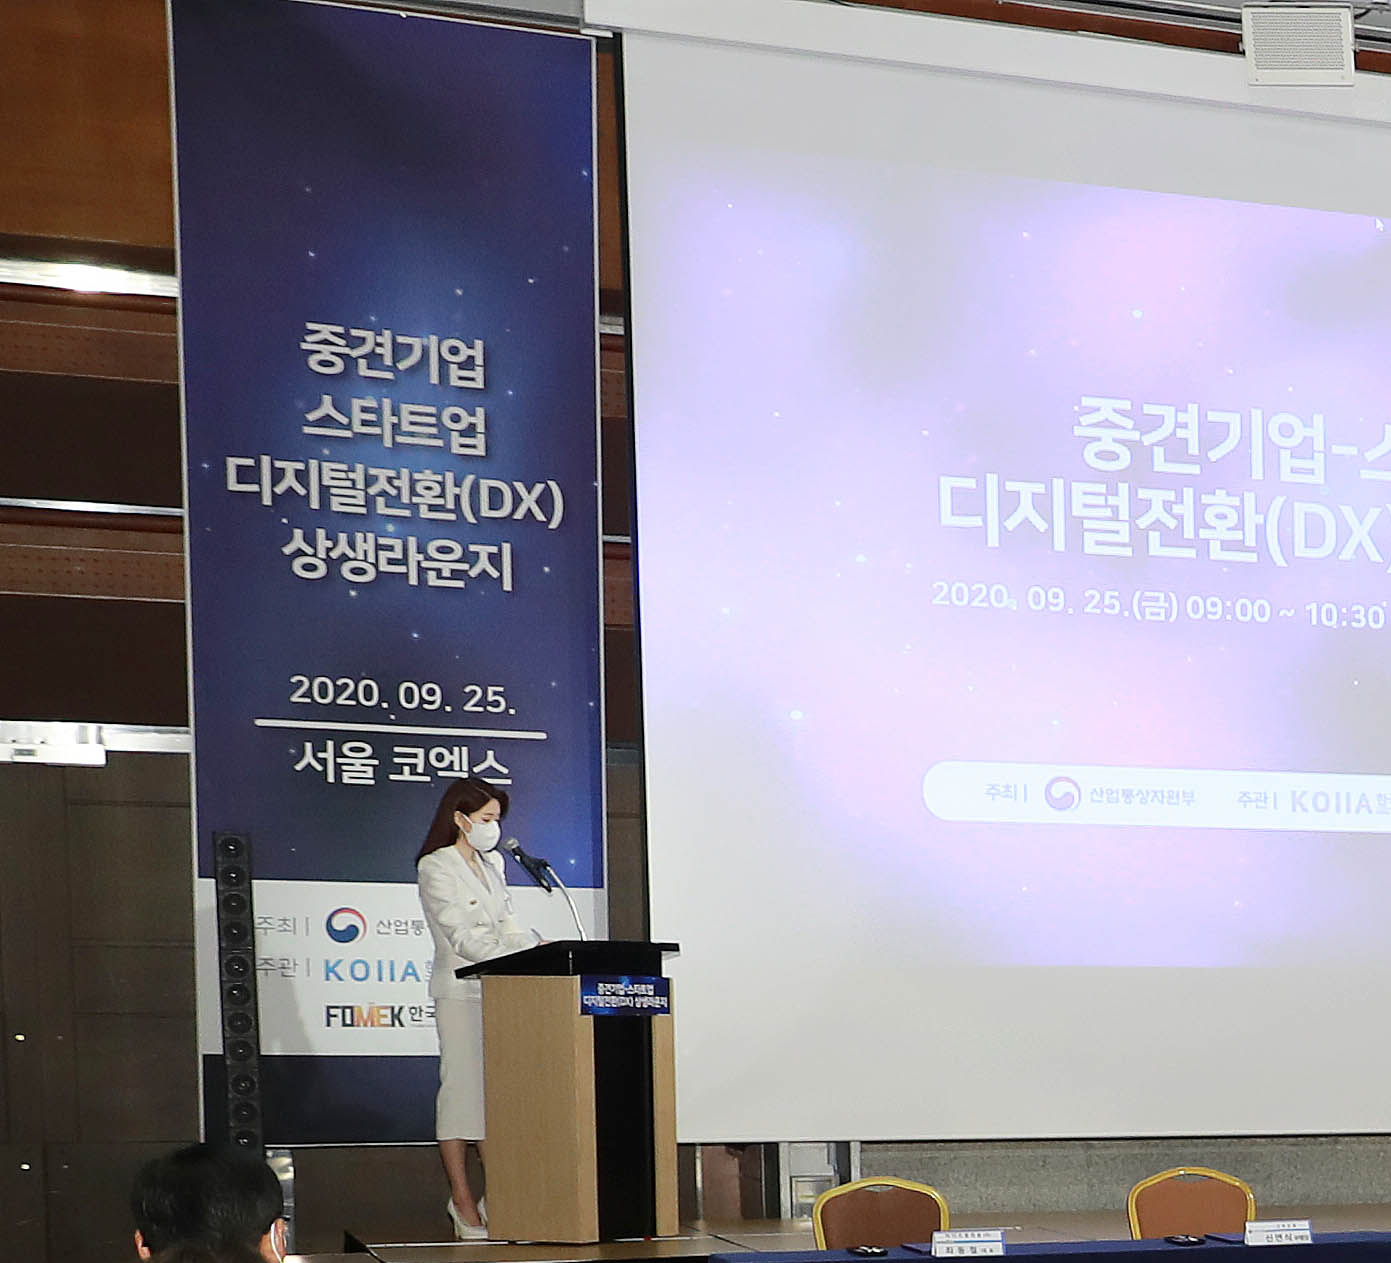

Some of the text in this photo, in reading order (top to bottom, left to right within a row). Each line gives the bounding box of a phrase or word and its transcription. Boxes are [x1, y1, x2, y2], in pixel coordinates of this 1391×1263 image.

[300, 322, 485, 389] 중견기업
[302, 395, 486, 457] 스타트업
[225, 455, 564, 530] 디지털전환(DX)
[281, 528, 513, 592] 상생라운지
[931, 581, 1017, 610] 2020.
[1027, 586, 1074, 615] 09.
[1186, 596, 1271, 623] 09:00
[1305, 601, 1386, 630] 10:30
[289, 675, 517, 715] 2020. 09. 25.
[293, 740, 512, 785] 서울 코엑스
[1237, 792, 1269, 810] 주관
[255, 916, 297, 935] 주최
[376, 919, 429, 936] 산업통
[256, 958, 298, 978] 주관
[324, 959, 421, 982] KOIIA
[325, 1004, 405, 1028] FOMEK
